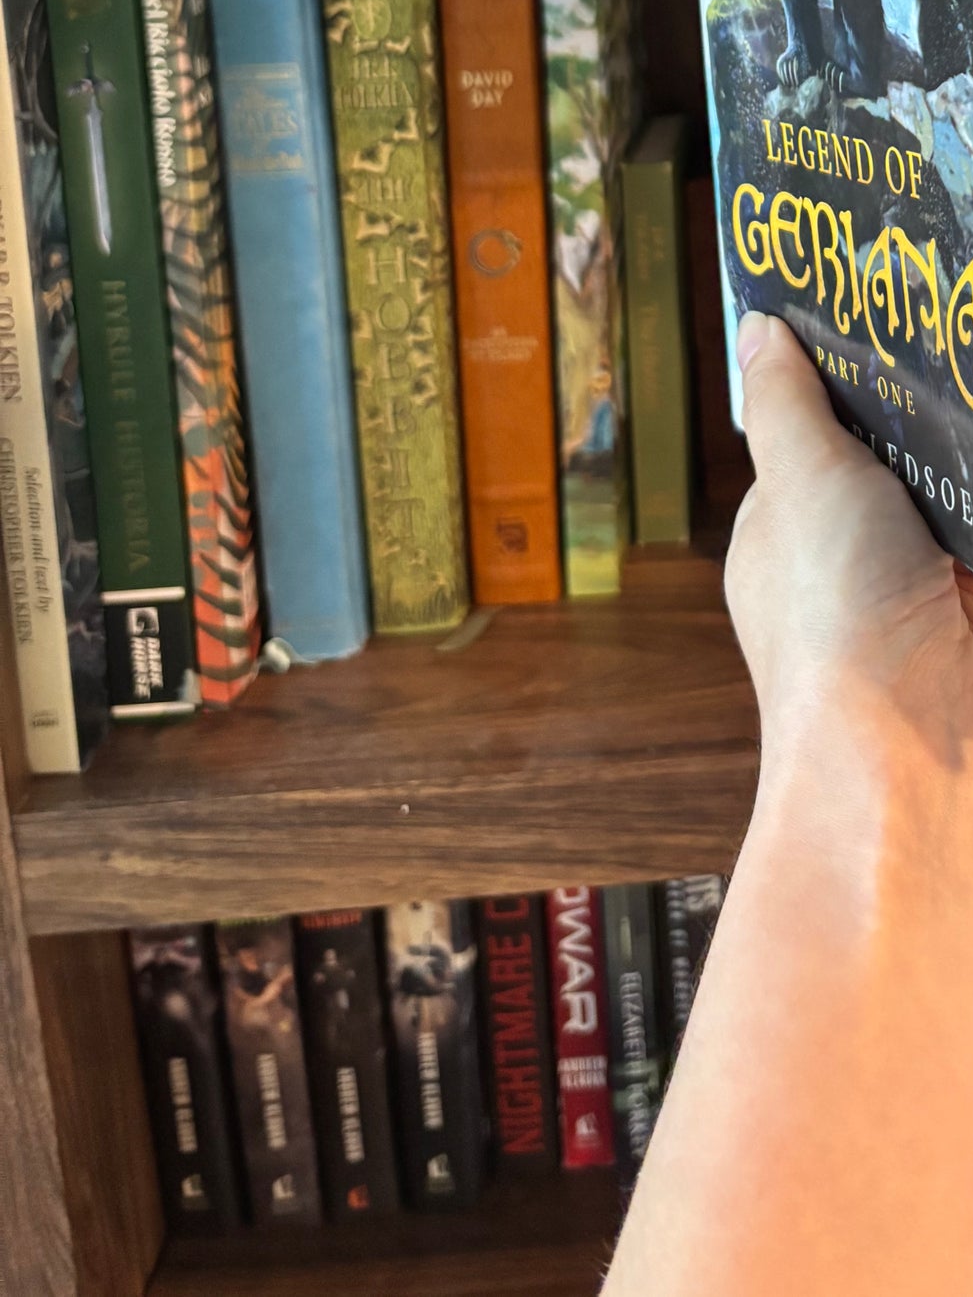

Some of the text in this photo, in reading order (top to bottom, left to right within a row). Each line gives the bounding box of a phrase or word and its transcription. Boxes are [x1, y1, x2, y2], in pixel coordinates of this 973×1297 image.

[461, 69, 514, 89] DAVID
[470, 88, 505, 109] DAY
[762, 119, 923, 200] LEGEND OF
[816, 345, 916, 415] PART ONE
[486, 933, 545, 1154] NIGHTMARE
